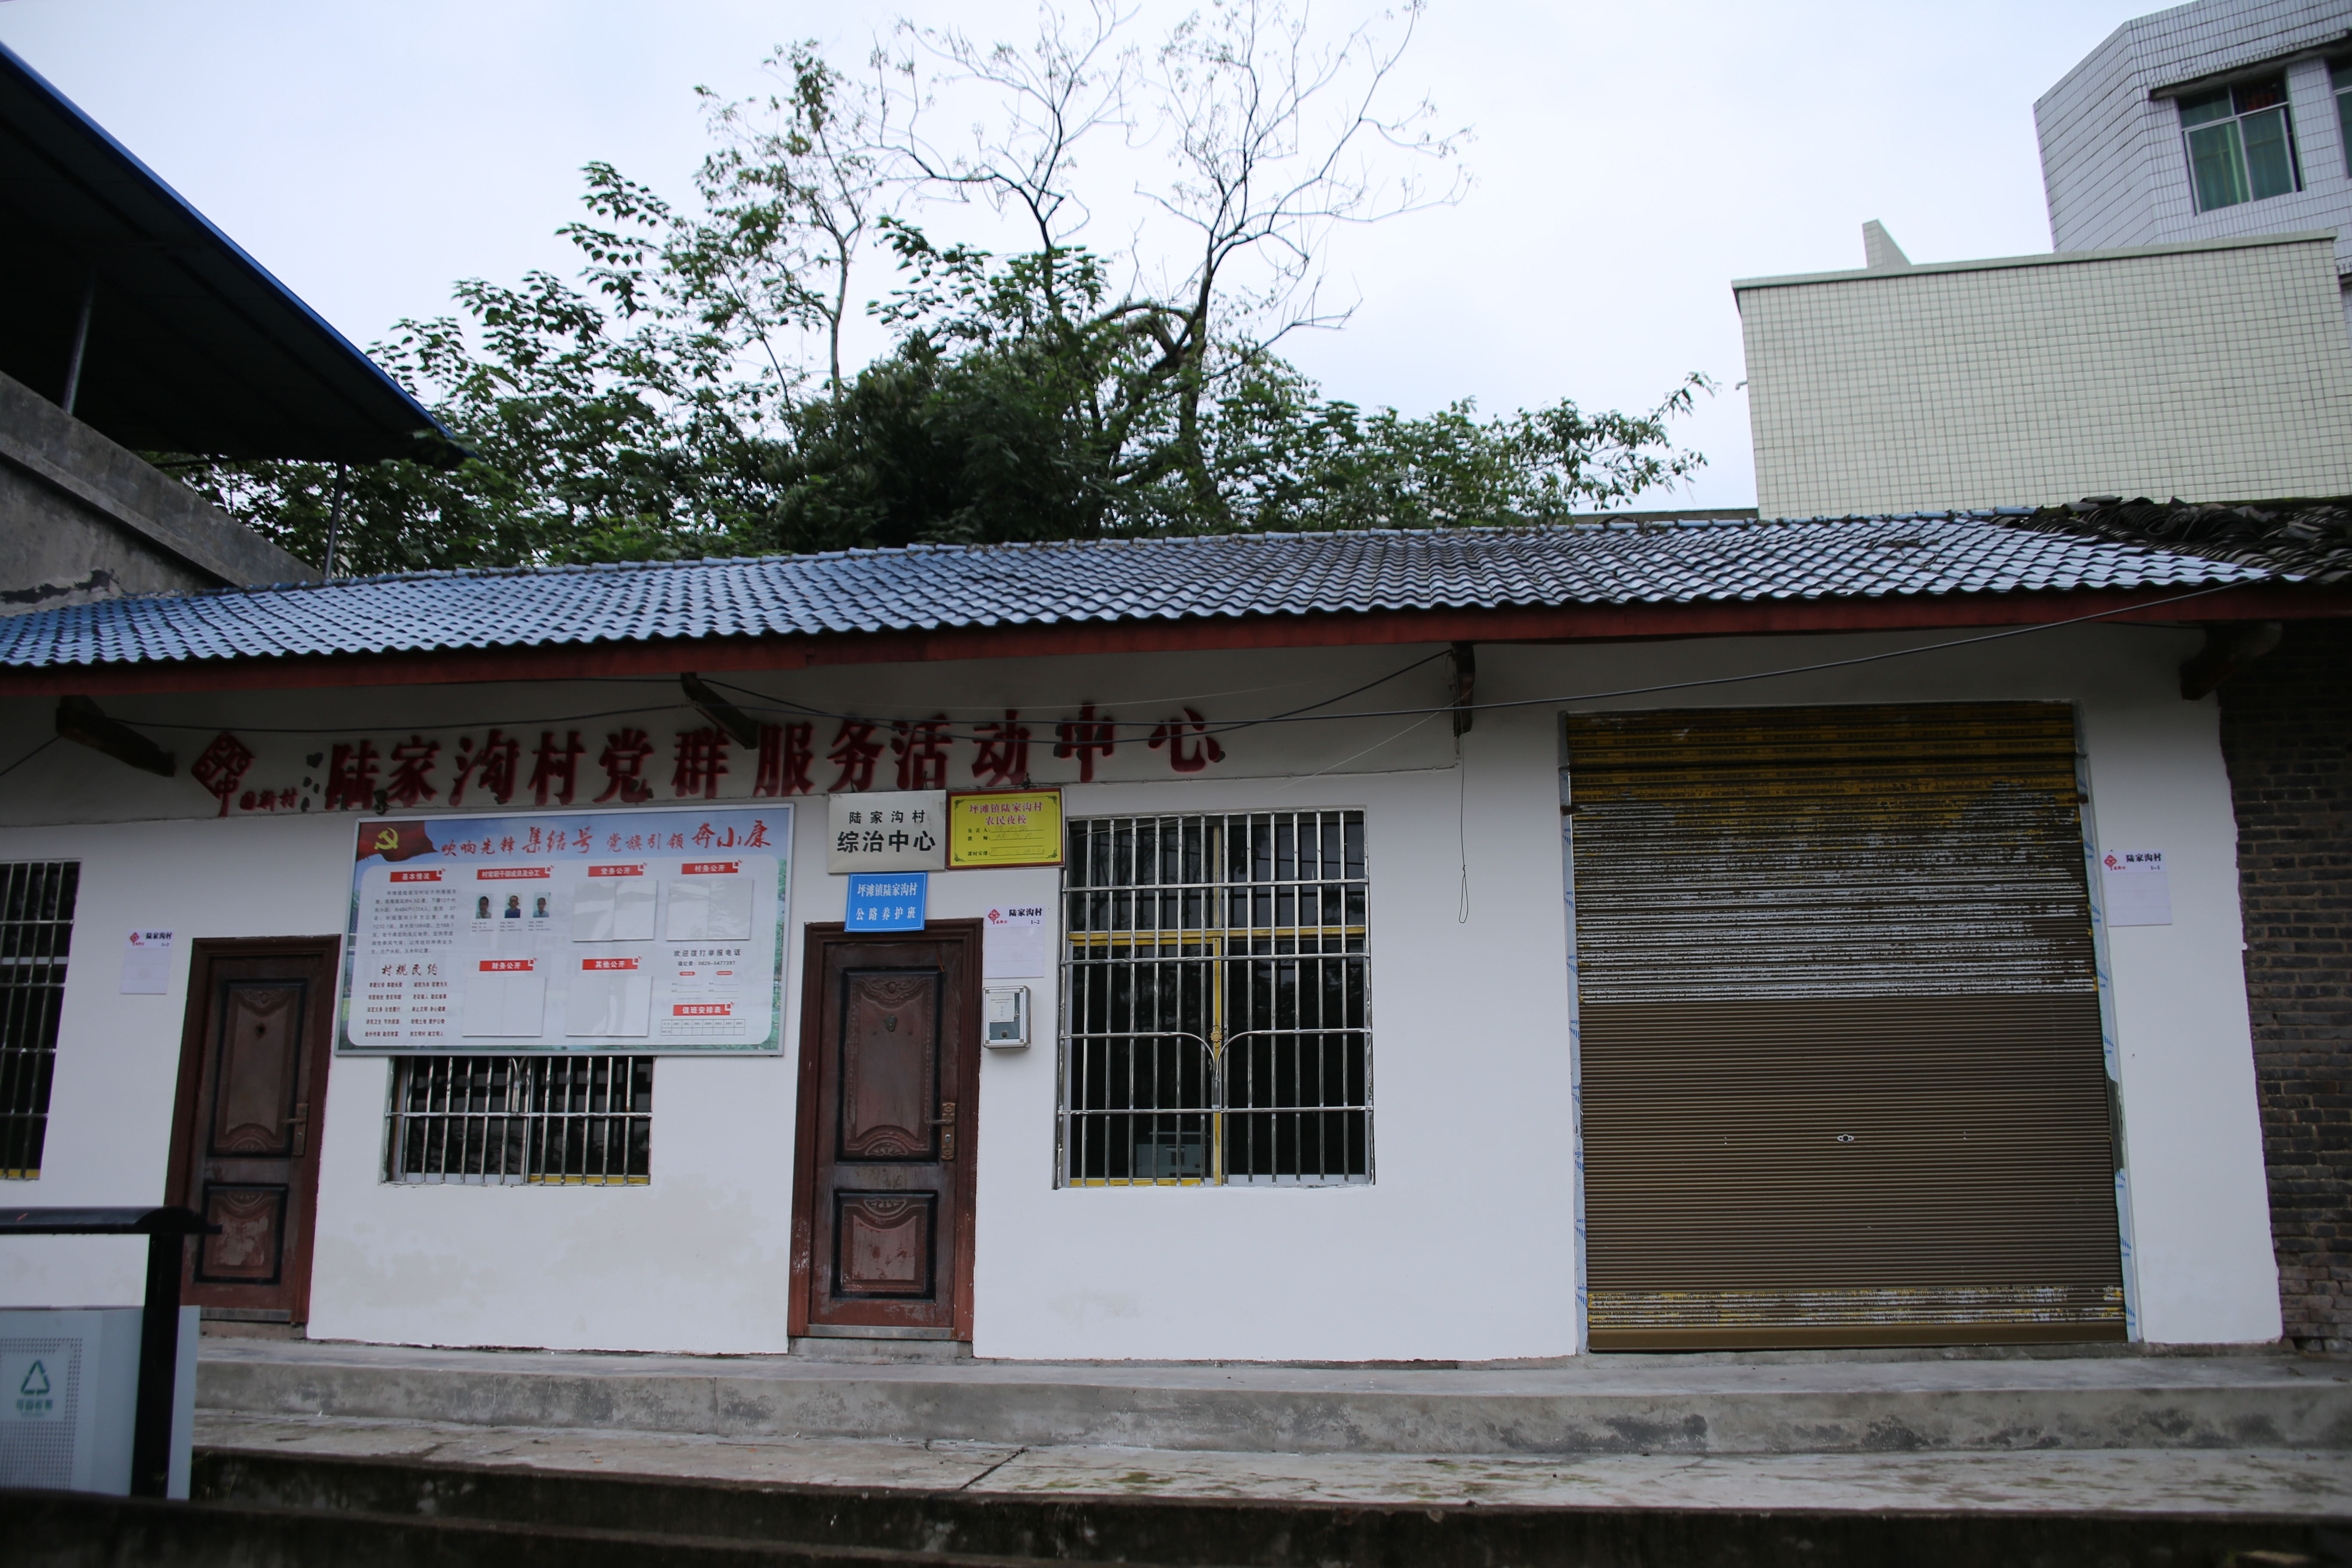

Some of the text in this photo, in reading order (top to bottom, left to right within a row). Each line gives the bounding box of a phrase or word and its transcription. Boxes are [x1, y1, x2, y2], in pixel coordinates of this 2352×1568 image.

[325, 703, 1222, 811] 陆家沟村党群服务活动中心
[969, 801, 1043, 814] 坪滩镇陆家沟村
[849, 810, 925, 824] 陆家沟村
[985, 815, 1027, 825] 农民夜校
[441, 820, 772, 857] 吹响先锋集结号 党旗引领奔小康
[836, 830, 936, 853] 综治中心
[2126, 853, 2162, 862] 陆家沟村
[600, 867, 631, 876] 党务公开
[694, 864, 725, 873] 村务公开
[401, 872, 430, 881] 基本情况
[857, 882, 918, 897] 坪滩镇陆家沟村
[855, 906, 917, 921] 公路养护班
[1009, 908, 1042, 917] 陆家沟村
[673, 949, 741, 957] 欢迎拨打举报电话
[595, 960, 626, 968] 其他公开
[382, 963, 438, 977] 村规民约
[682, 1006, 721, 1014] 值班安排表
